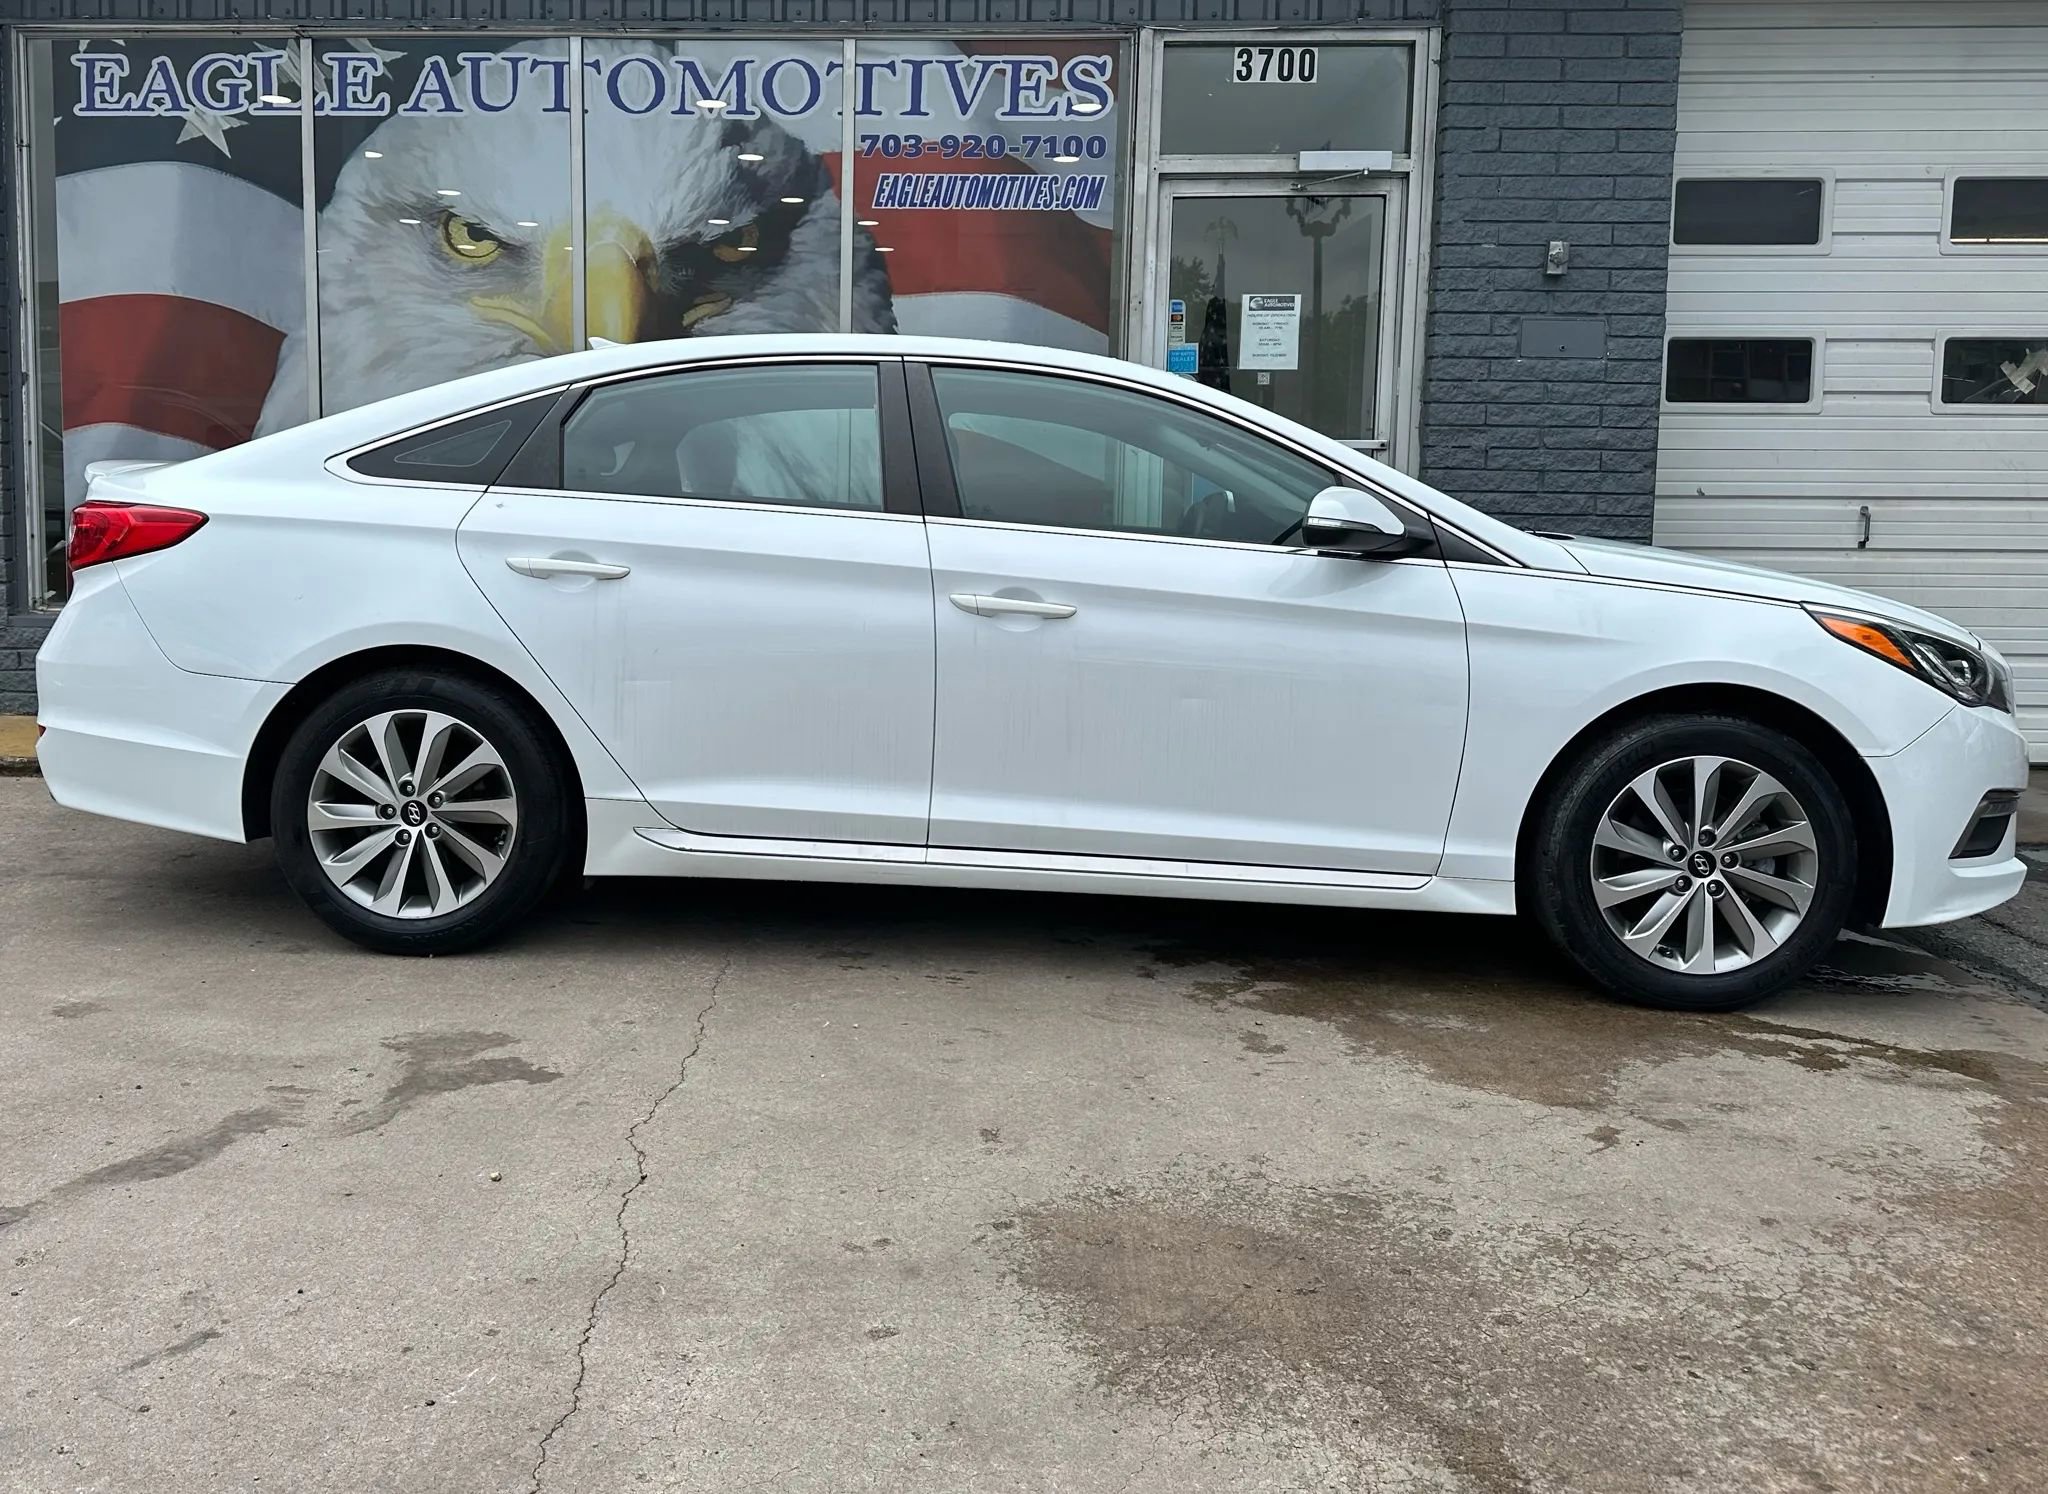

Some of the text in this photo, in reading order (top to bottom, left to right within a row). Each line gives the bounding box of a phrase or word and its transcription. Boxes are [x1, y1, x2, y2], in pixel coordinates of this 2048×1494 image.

[1236, 48, 1315, 82] 3700
[72, 53, 1114, 121] EAGLE AUTOMOTIVES
[860, 134, 1107, 159] 703-920-7100
[872, 173, 1109, 211] EAGLEAUTOMOTIVES.COM
